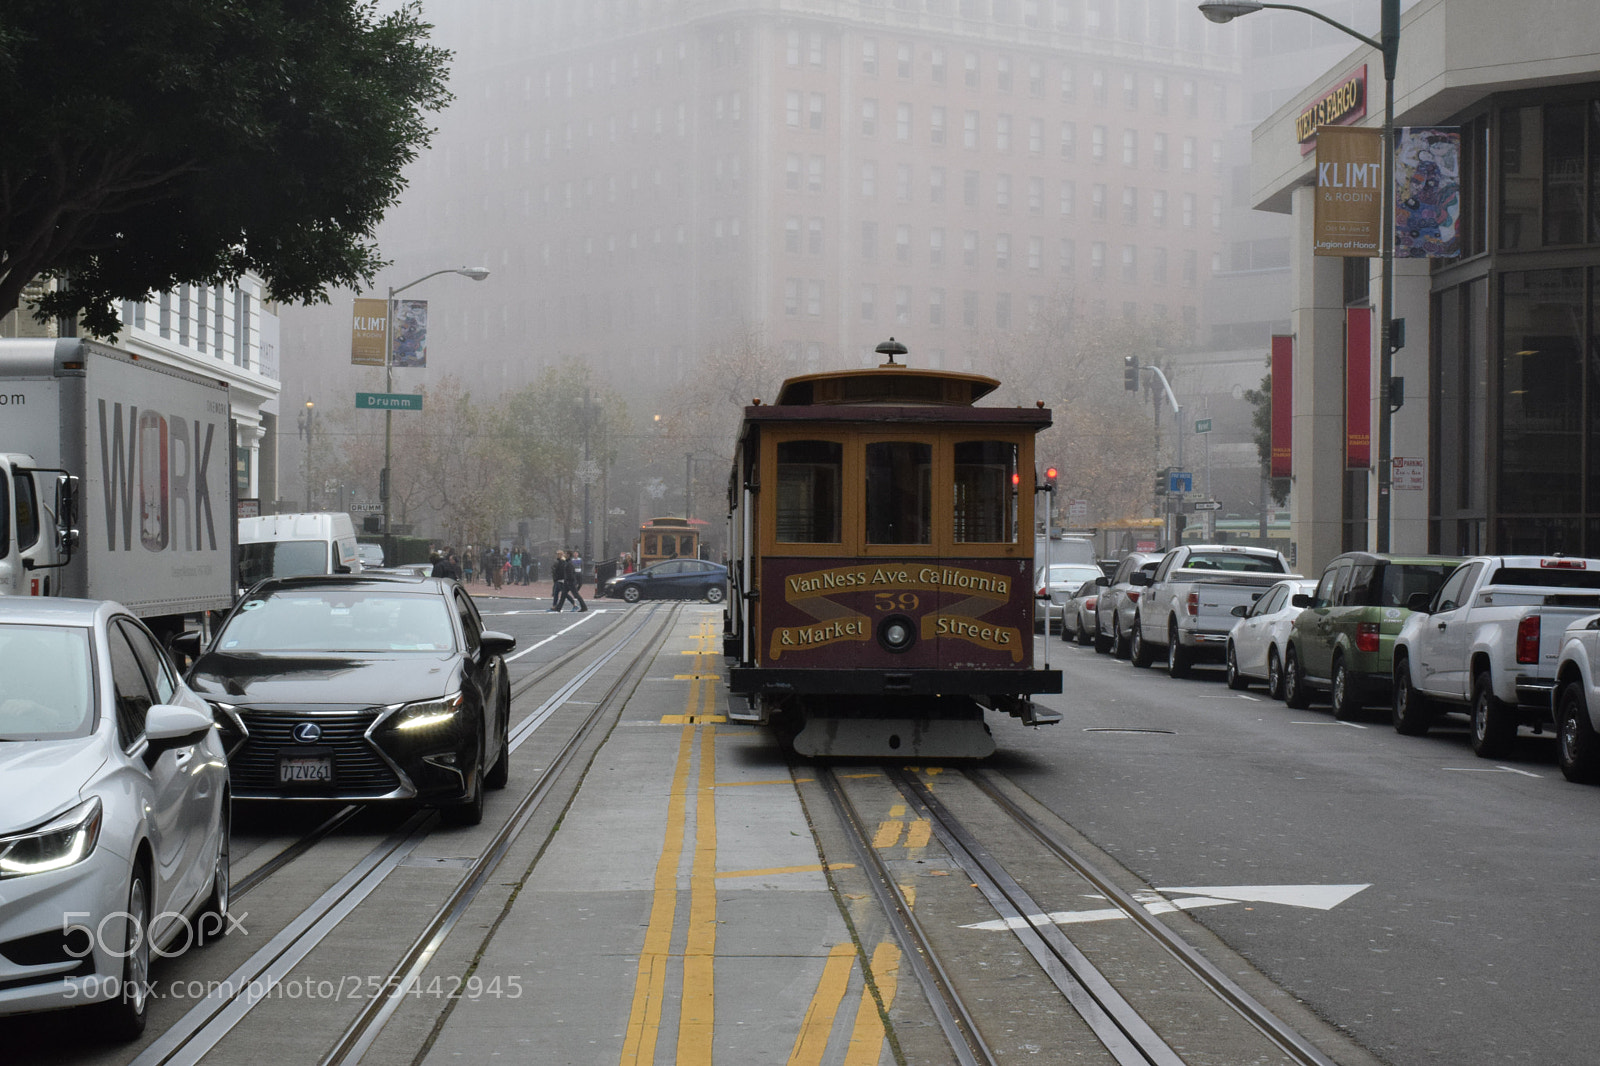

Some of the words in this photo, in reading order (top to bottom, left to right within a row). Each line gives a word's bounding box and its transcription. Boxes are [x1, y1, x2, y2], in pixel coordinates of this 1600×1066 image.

[1295, 100, 1325, 143] WELLS
[1326, 78, 1357, 125] FARGO
[1319, 162, 1380, 188] KLIMT
[1324, 192, 1332, 201] &
[1336, 193, 1373, 202] RODIN
[1316, 240, 1342, 250] Legion
[1343, 241, 1352, 249] of
[1353, 241, 1377, 249] Honor
[354, 316, 386, 332] KLIMT
[368, 396, 411, 407] Drumm
[98, 398, 217, 553] WORK
[790, 577, 821, 593] Van
[822, 572, 866, 589] Ness
[919, 568, 1007, 594] California
[874, 592, 920, 612] 59
[781, 629, 794, 645] &
[798, 620, 863, 645] Market
[936, 618, 1012, 644] Streets
